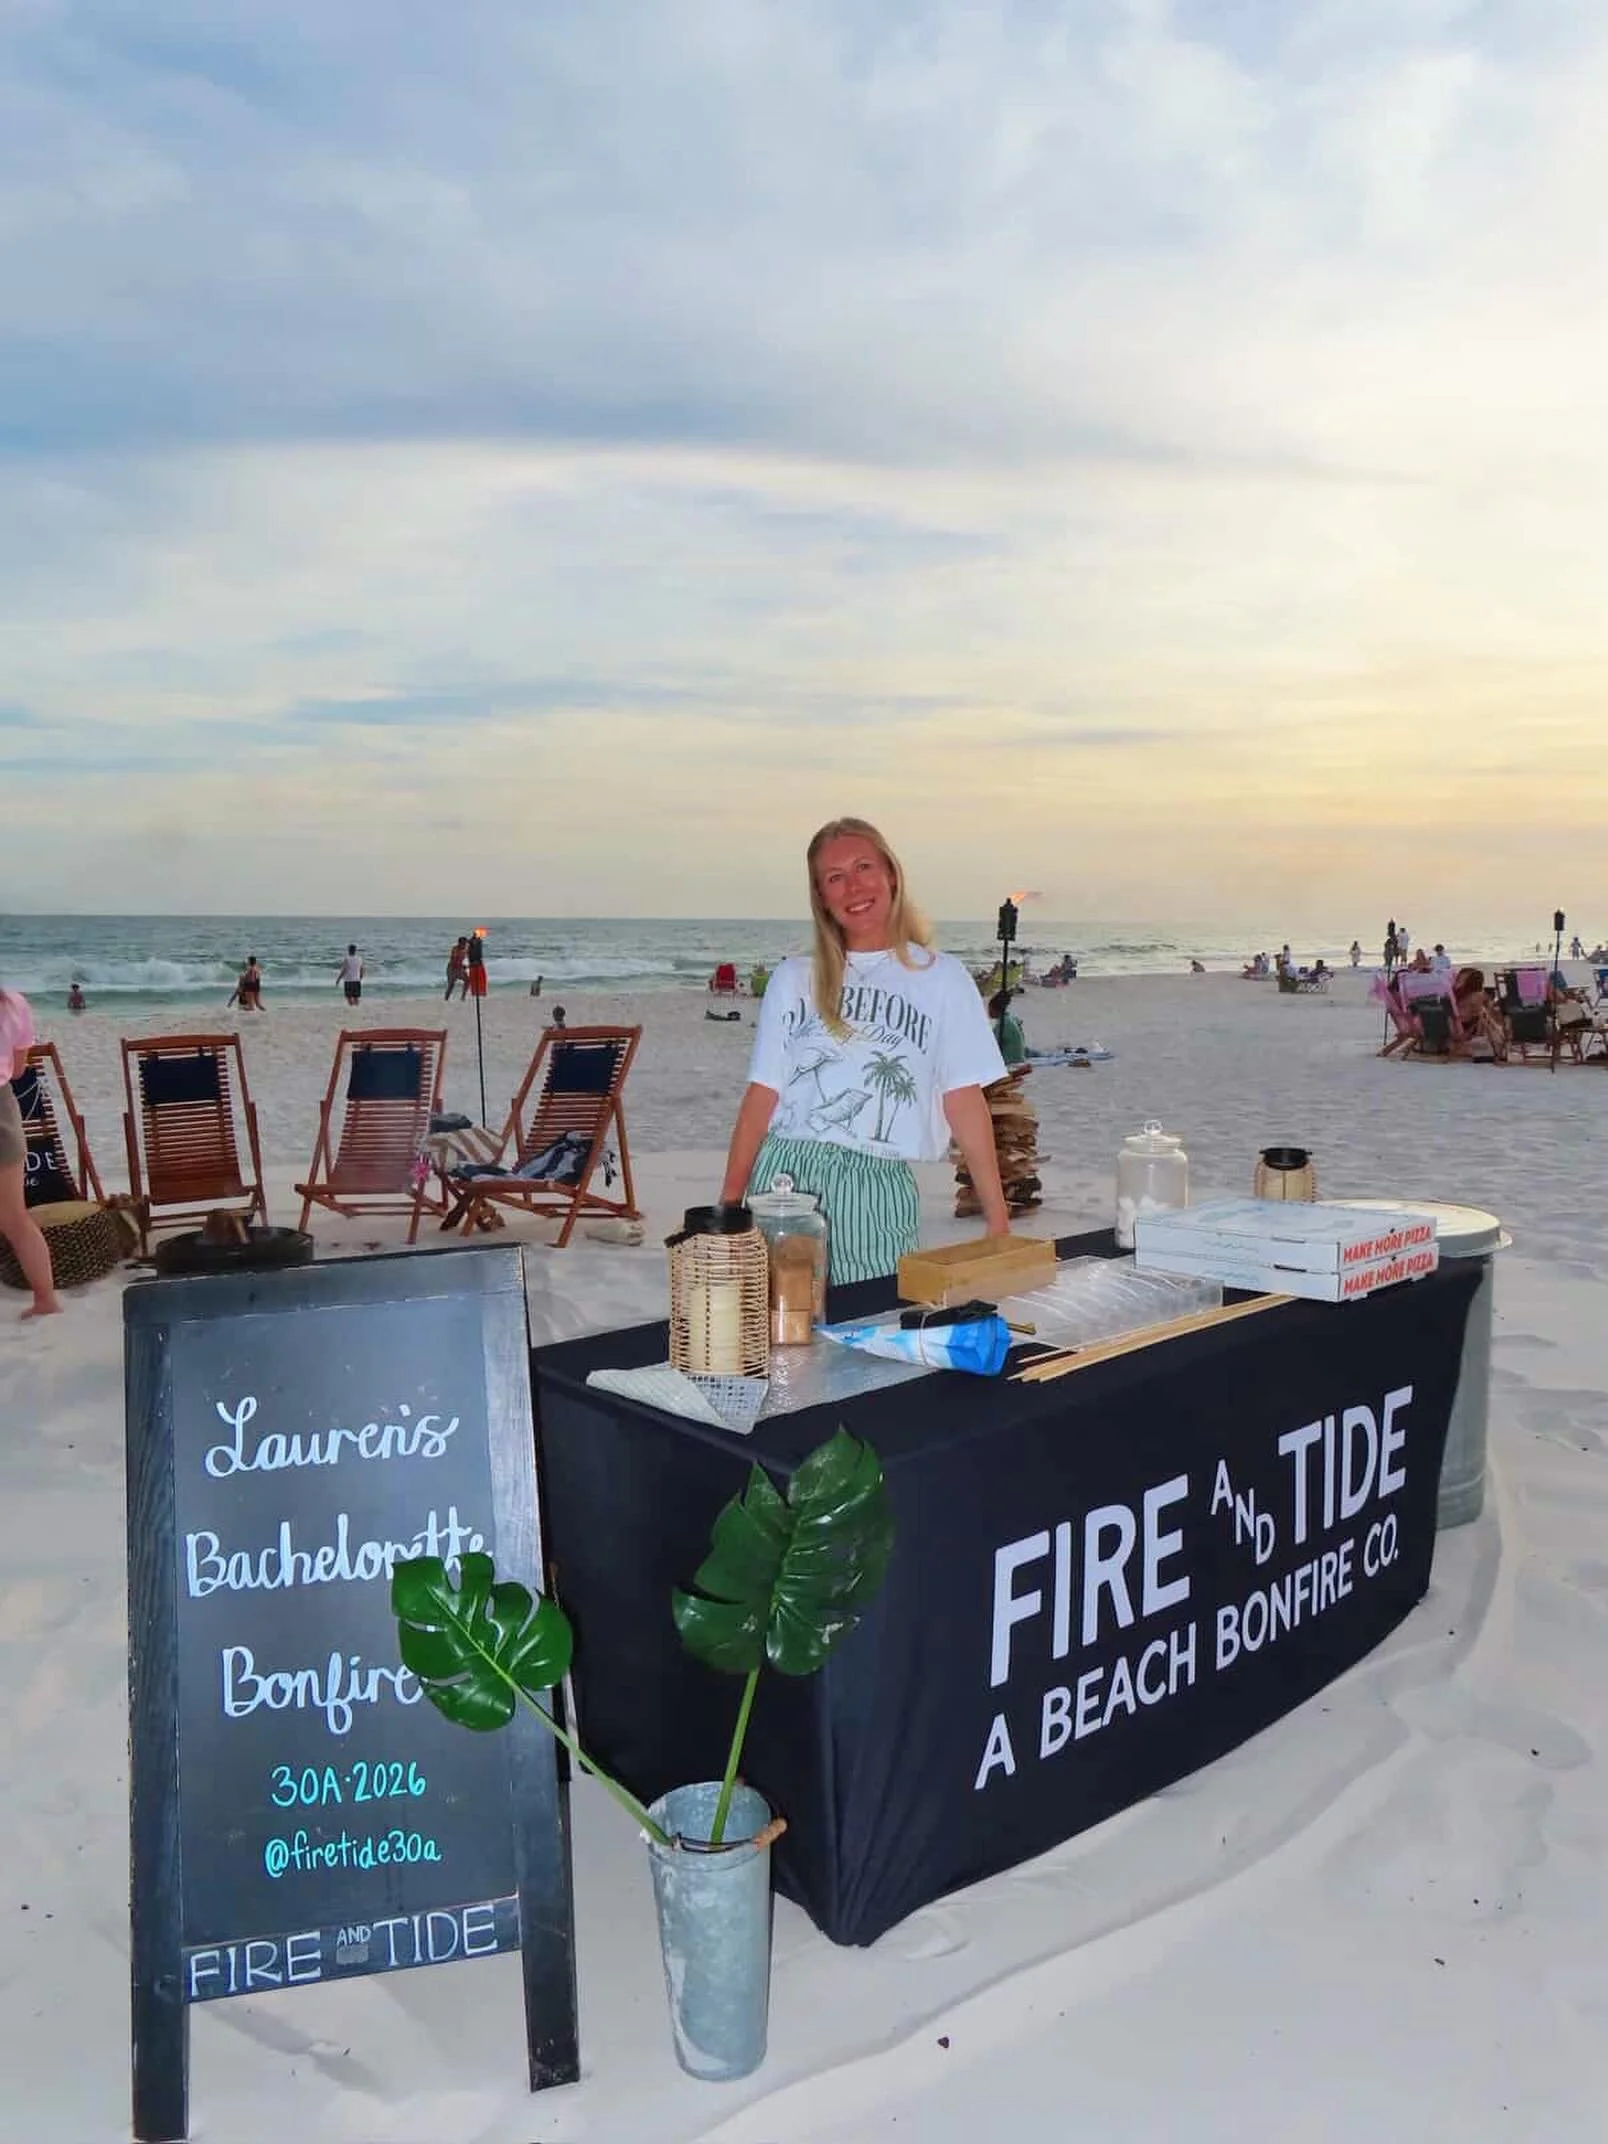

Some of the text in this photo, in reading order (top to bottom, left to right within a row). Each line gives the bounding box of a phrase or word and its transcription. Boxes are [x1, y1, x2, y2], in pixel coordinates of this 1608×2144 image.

[838, 985, 933, 1055] BEFORE
[1343, 1224, 1432, 1265] MAKE MORE PIZZA
[1343, 1252, 1434, 1296] MAKE MORE PIZZA
[205, 1396, 460, 1478] Lauren's
[990, 1384, 1414, 1688] FIRE AND TIDE
[222, 1645, 424, 1735] Bonfire
[974, 1513, 1399, 1791] A BEACH BONFIRE CO.
[264, 1829, 442, 1878] @firetide30a
[189, 1904, 499, 1998] FIRE AND TIDE
